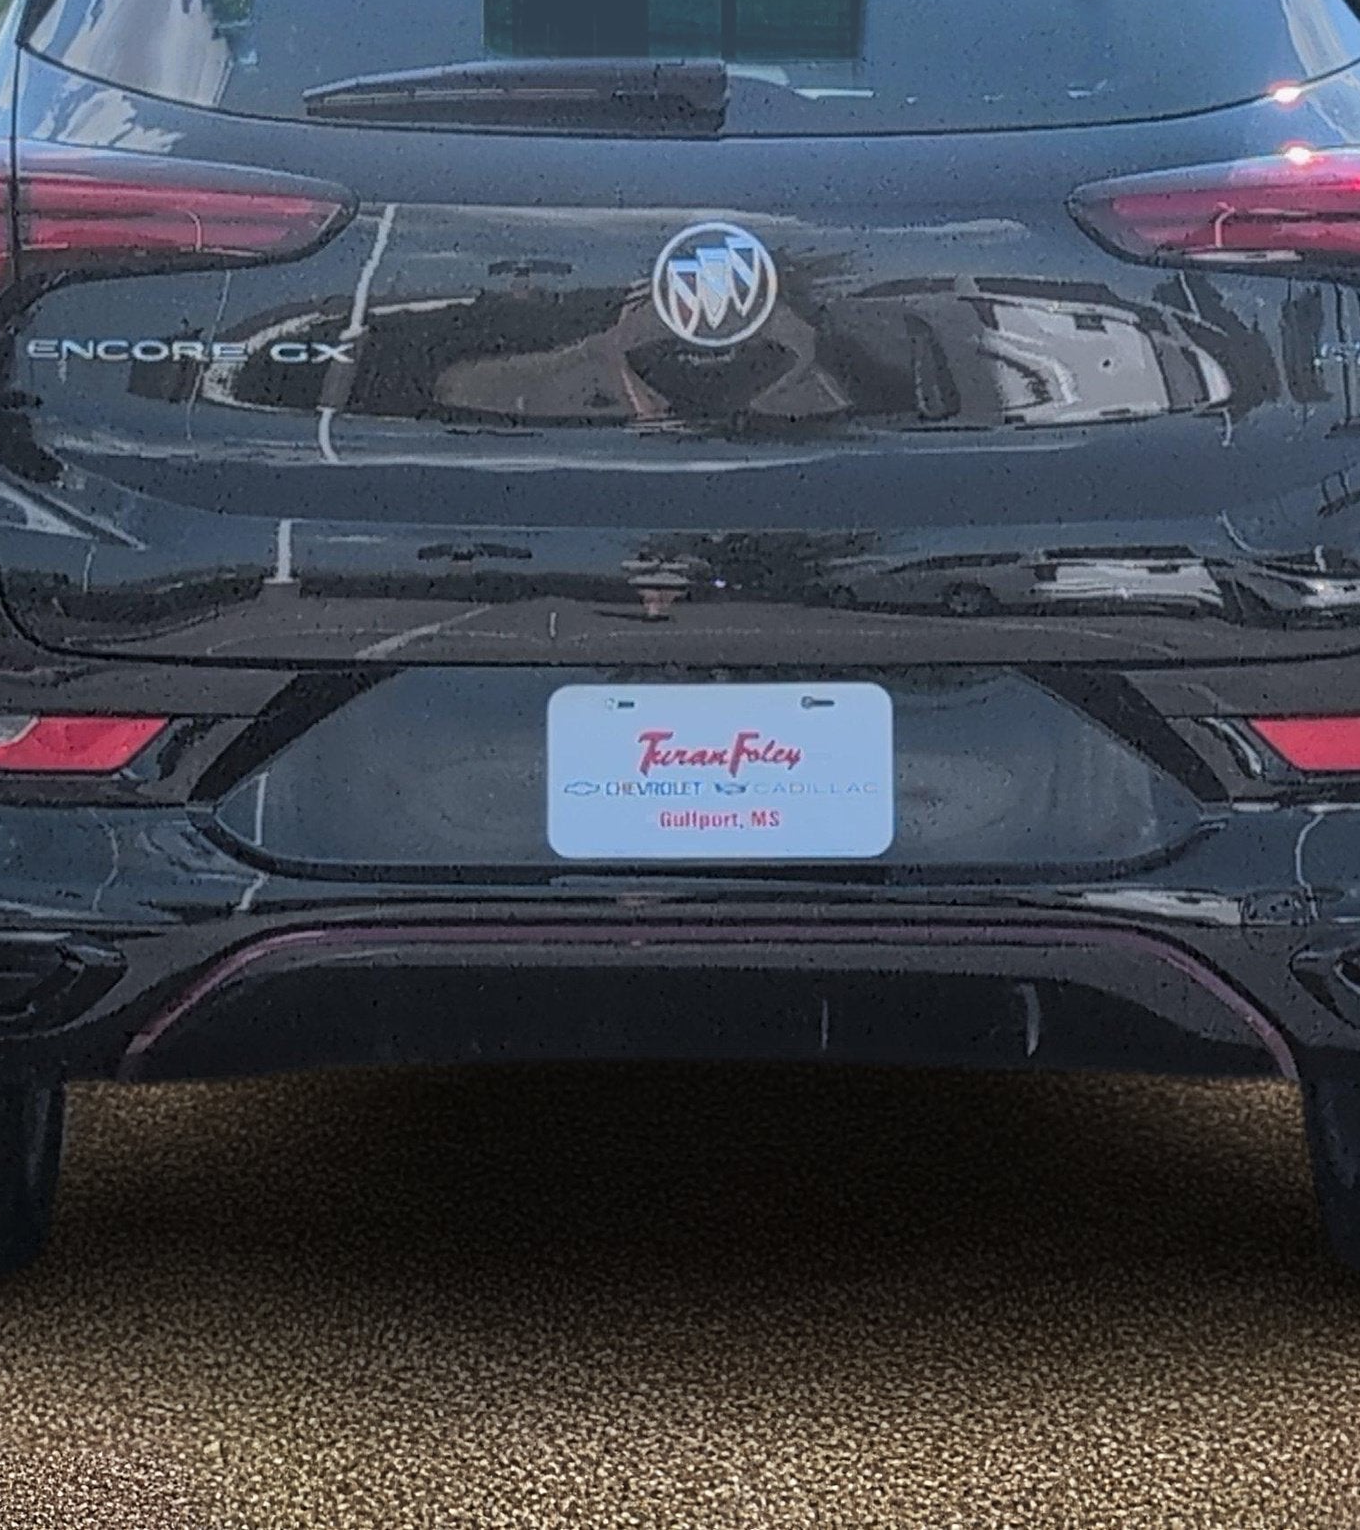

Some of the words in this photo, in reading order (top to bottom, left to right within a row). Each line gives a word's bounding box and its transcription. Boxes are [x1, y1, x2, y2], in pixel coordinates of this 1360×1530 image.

[27, 339, 249, 362] ENCORE
[270, 342, 355, 364] GX
[637, 731, 728, 777] Turan
[729, 731, 804, 777] Foley
[606, 782, 702, 795] CHEVROLET
[754, 782, 879, 794] CADILLAC
[659, 811, 744, 830] Gulfport,
[750, 811, 781, 827] MS
